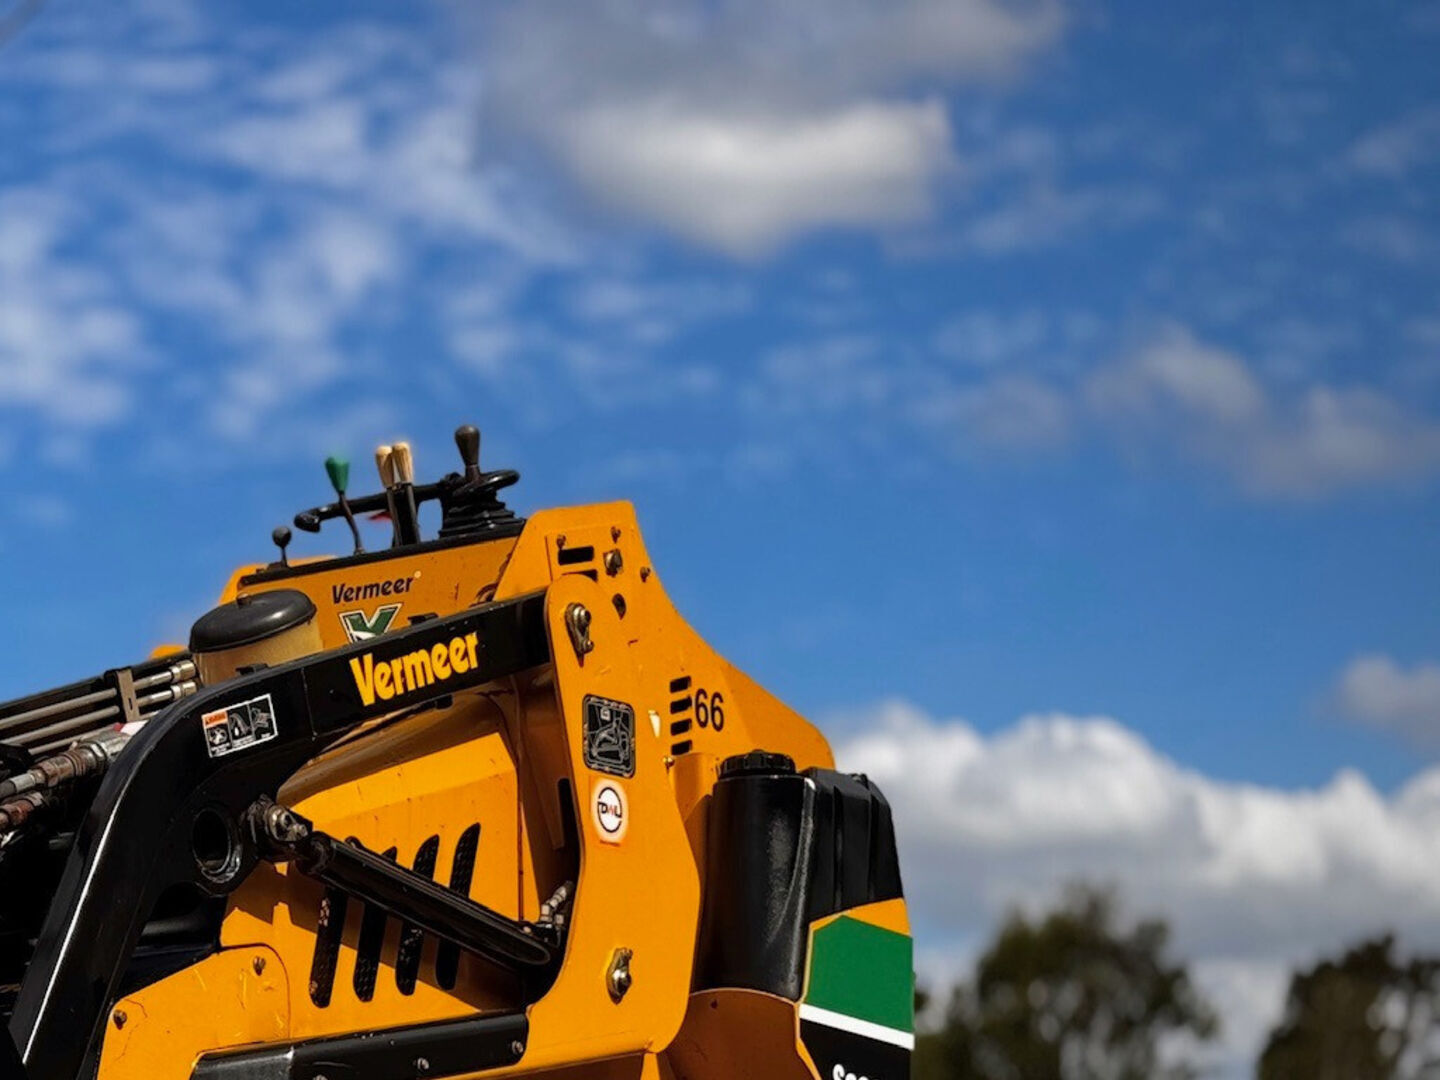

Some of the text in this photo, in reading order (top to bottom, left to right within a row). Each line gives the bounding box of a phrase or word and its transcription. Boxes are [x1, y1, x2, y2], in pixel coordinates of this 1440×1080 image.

[332, 576, 414, 604] Vermeer
[350, 631, 479, 706] Vermeer
[694, 688, 724, 732] 66
